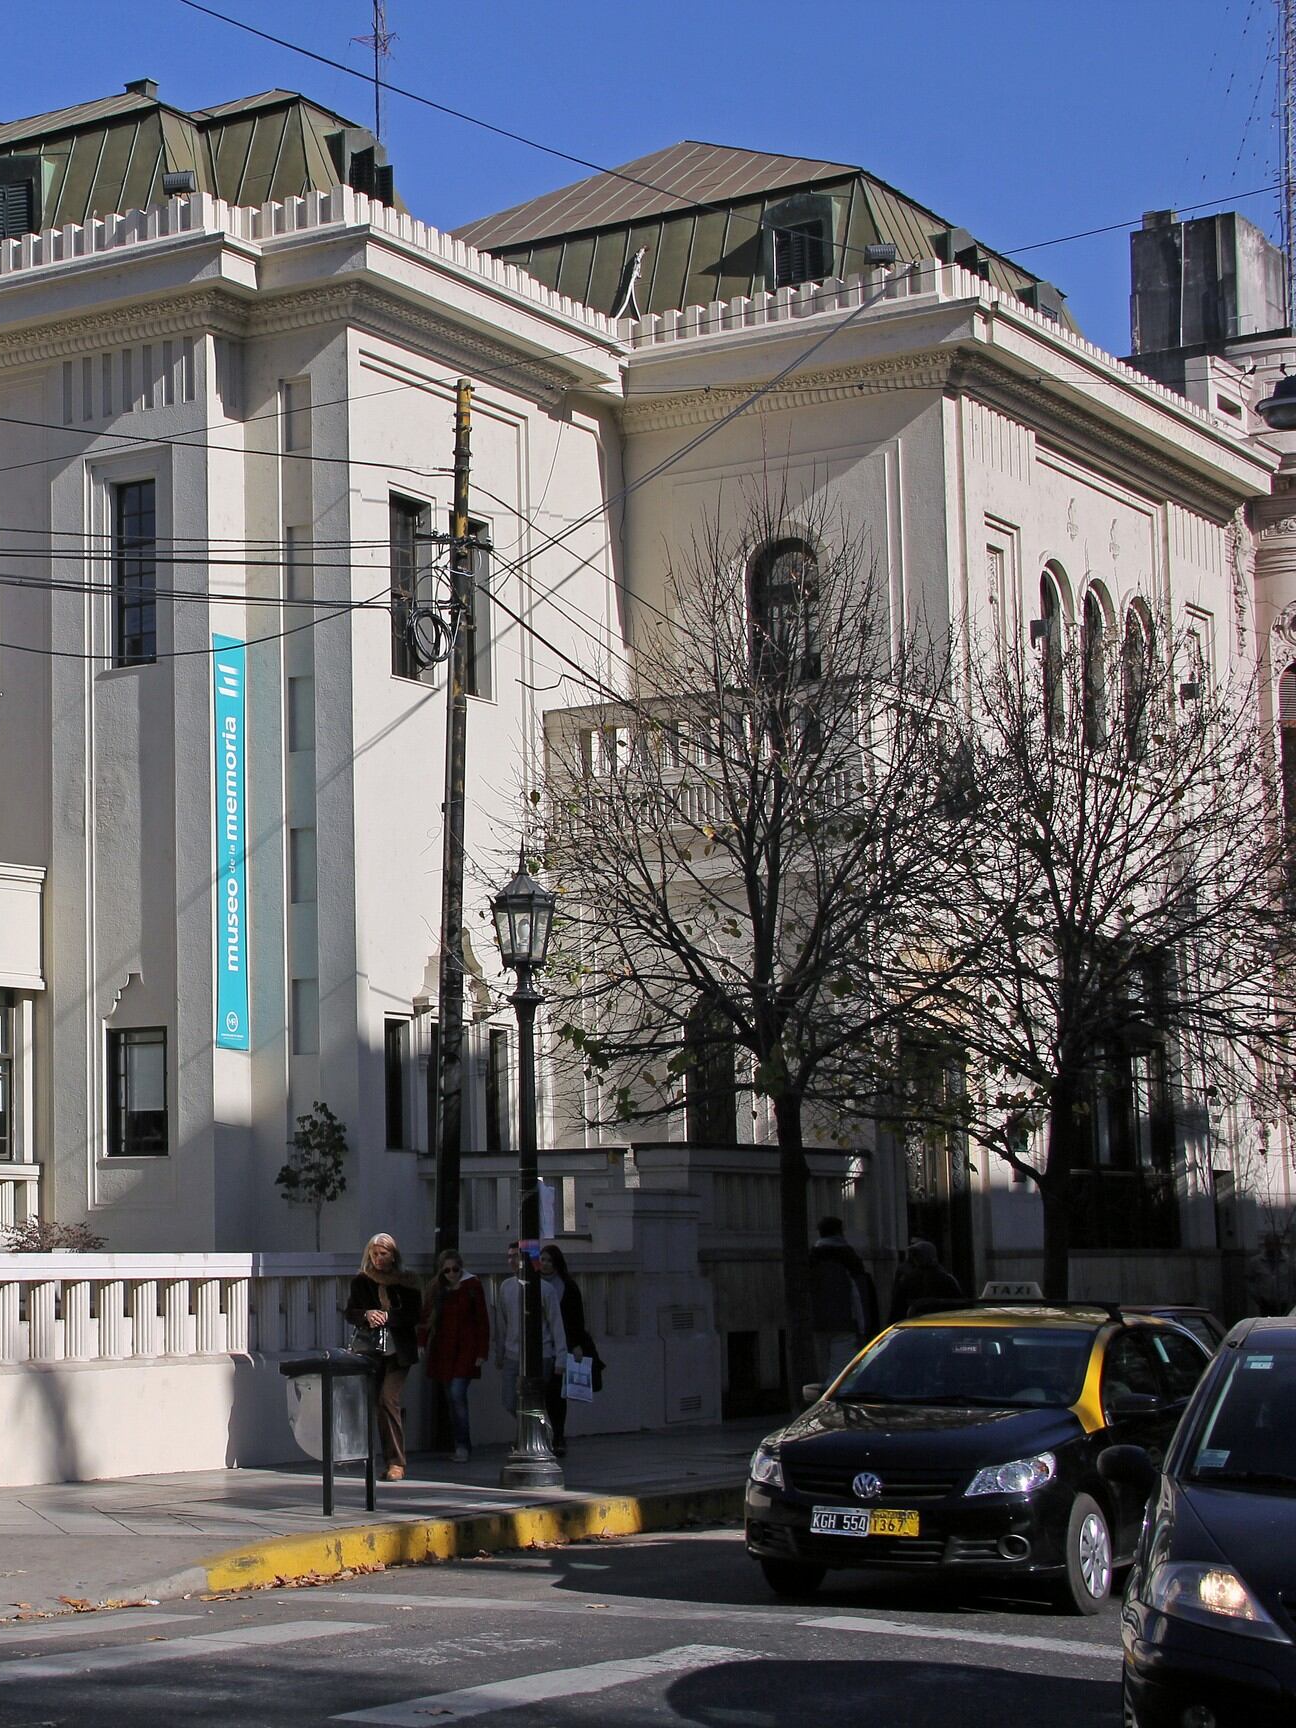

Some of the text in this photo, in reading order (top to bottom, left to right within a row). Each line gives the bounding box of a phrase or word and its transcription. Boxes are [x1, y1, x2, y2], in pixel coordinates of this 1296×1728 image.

[221, 716, 239, 972] museo de la memoria
[991, 1285, 1031, 1296] TAXI
[812, 1513, 836, 1529] KGH
[842, 1515, 866, 1531] 554
[872, 1518, 904, 1532] 1367
